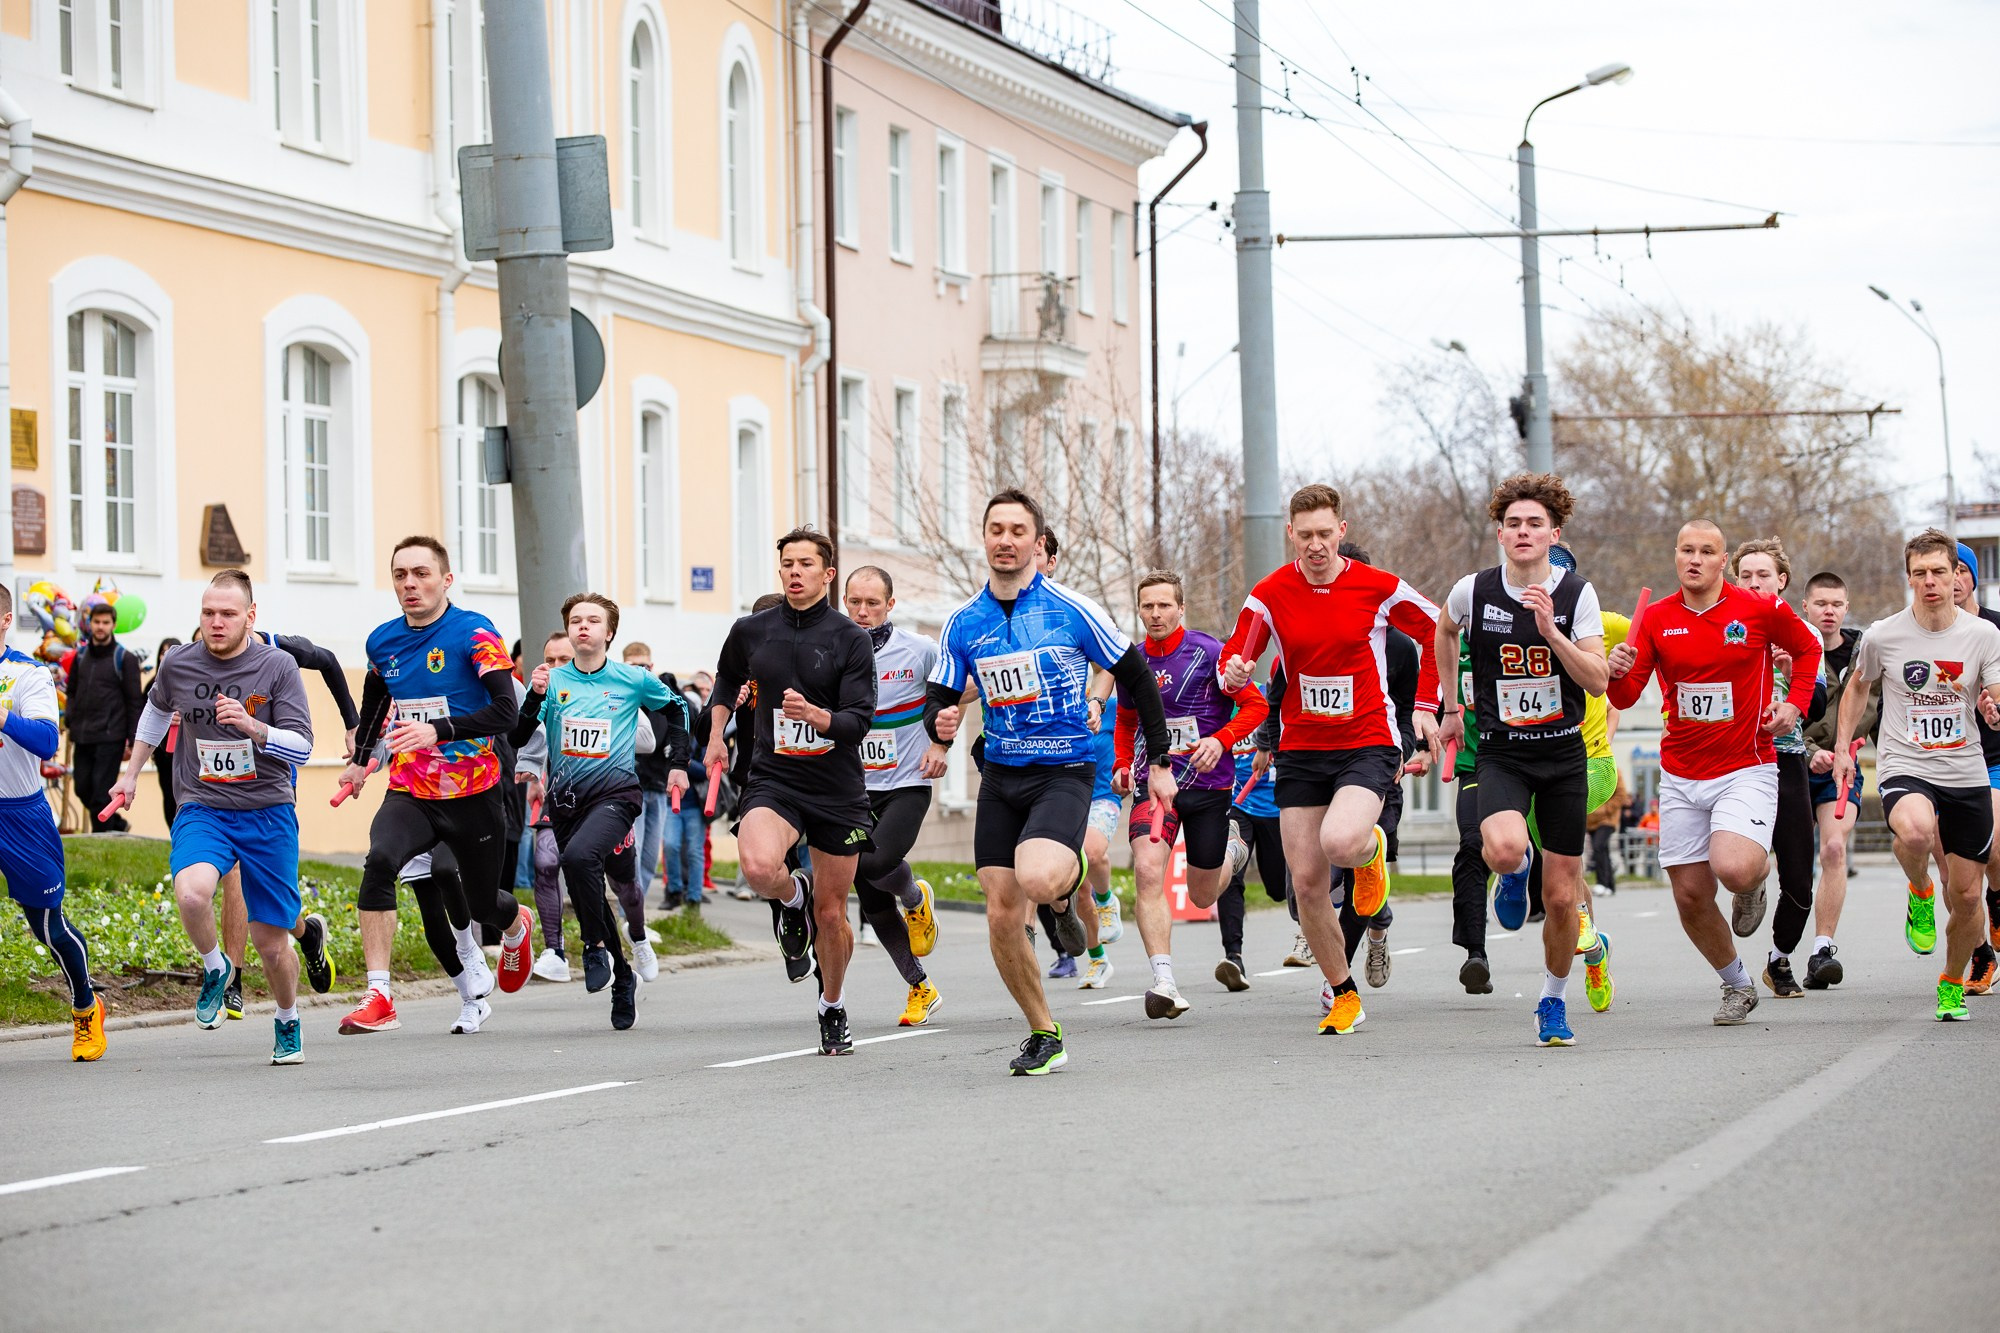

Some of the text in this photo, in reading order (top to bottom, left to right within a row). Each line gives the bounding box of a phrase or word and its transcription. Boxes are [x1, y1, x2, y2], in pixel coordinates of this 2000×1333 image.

[1499, 643, 1552, 677] 28
[889, 668, 914, 681] КАРТА
[990, 667, 1023, 694] 101
[194, 682, 242, 700] ОАО
[1310, 688, 1341, 709] 102
[1519, 691, 1543, 713] 64
[1691, 695, 1713, 716] 87
[571, 728, 600, 748] 107
[792, 722, 815, 744] 70
[1920, 717, 1953, 740] 109
[860, 741, 885, 760] 106
[1001, 739, 1072, 750] ПЕТРОЗАВОДСК
[213, 752, 235, 772] 66
